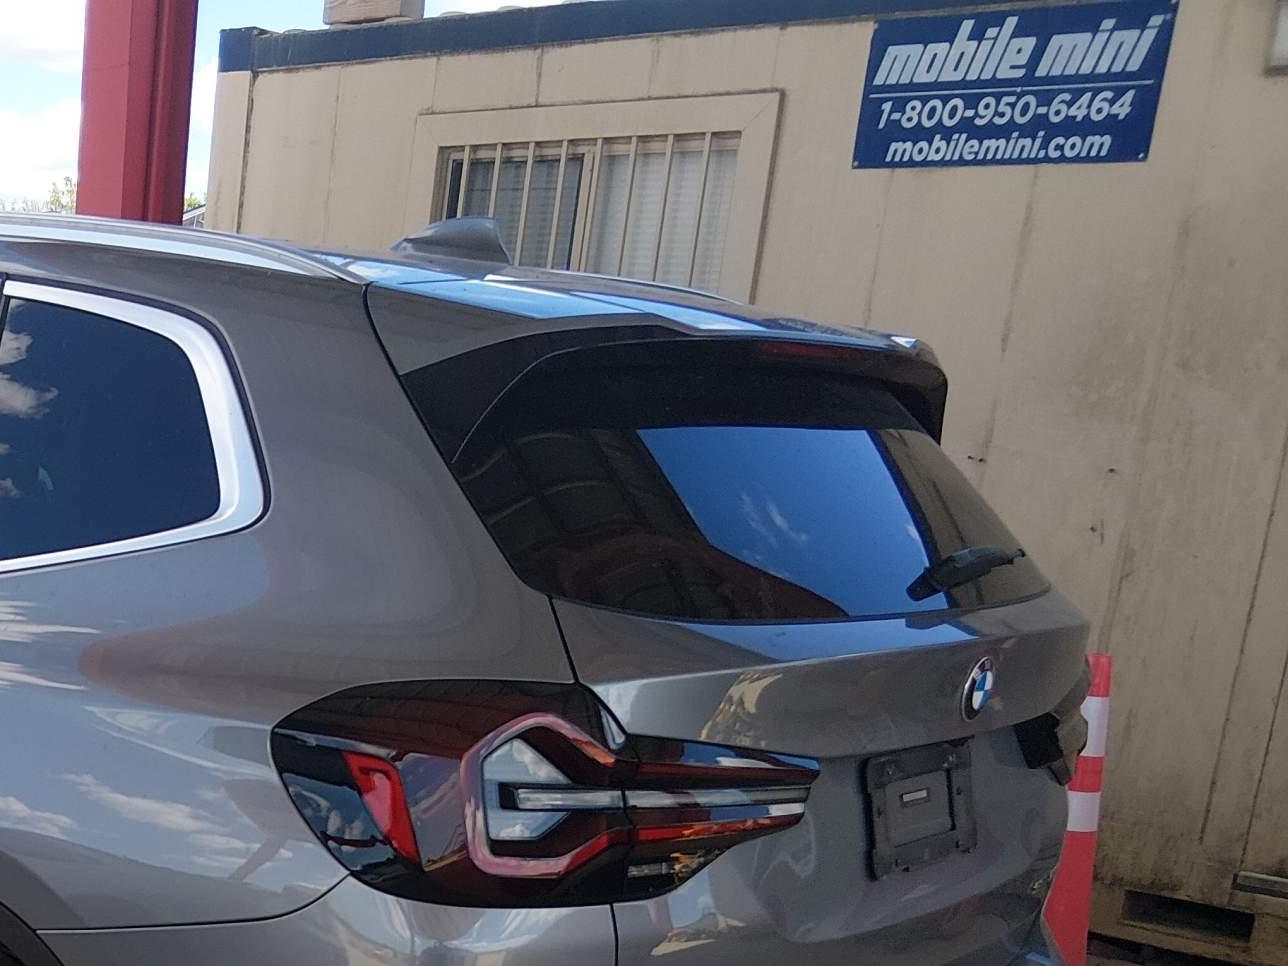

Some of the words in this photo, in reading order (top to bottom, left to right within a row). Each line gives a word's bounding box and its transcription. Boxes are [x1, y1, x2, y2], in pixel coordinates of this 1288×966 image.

[873, 16, 1038, 86] mobile
[1035, 14, 1164, 77] mini
[877, 89, 1136, 129] 1-800-950-6464
[885, 130, 1112, 162] mobilemini.com
